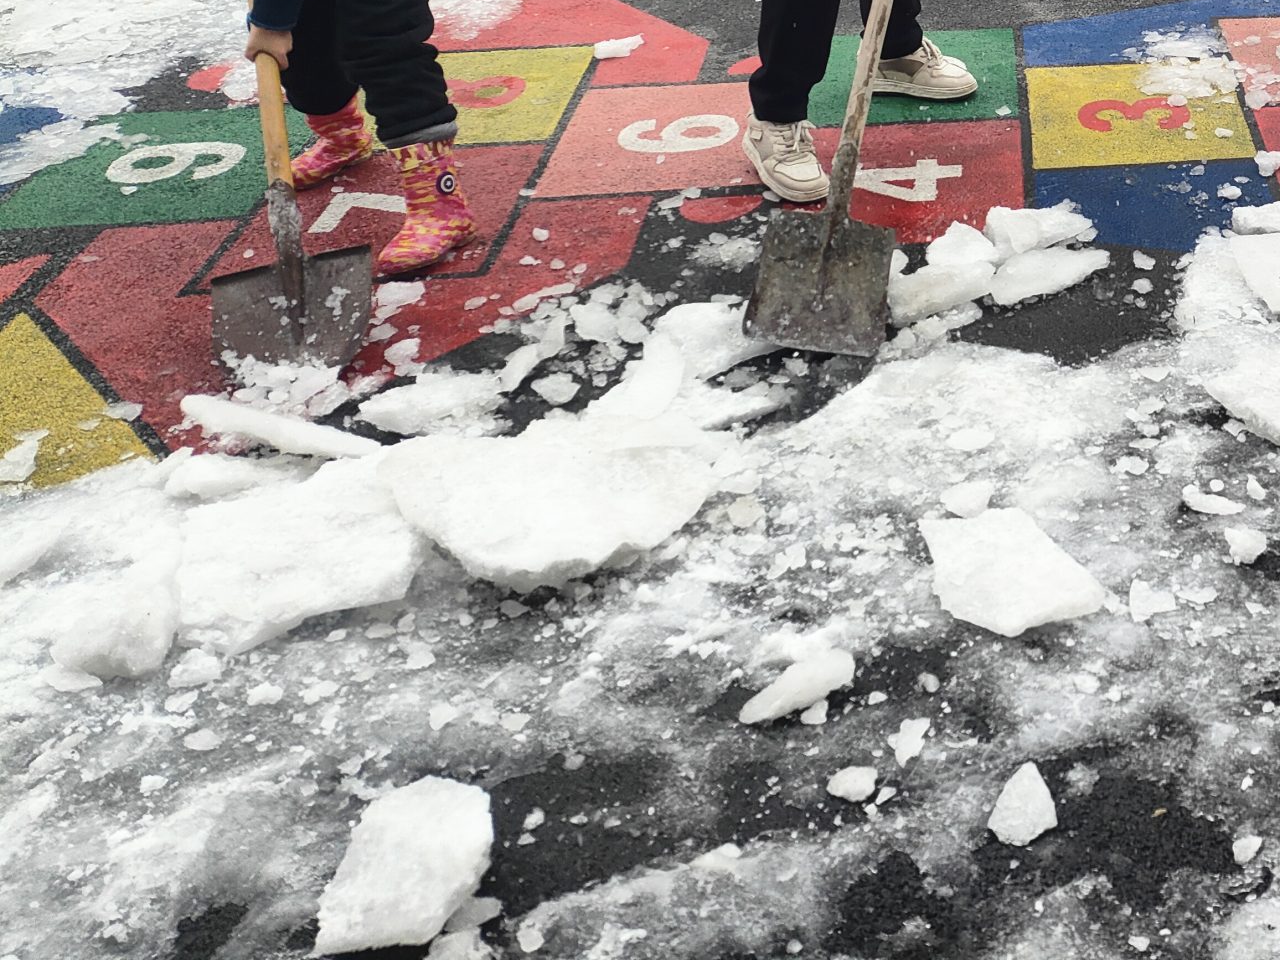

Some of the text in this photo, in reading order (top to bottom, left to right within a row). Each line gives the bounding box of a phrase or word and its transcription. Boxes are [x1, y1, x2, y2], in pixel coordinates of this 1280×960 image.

[617, 114, 740, 153] 6
[1076, 97, 1191, 133] 3
[853, 158, 962, 201] 4
